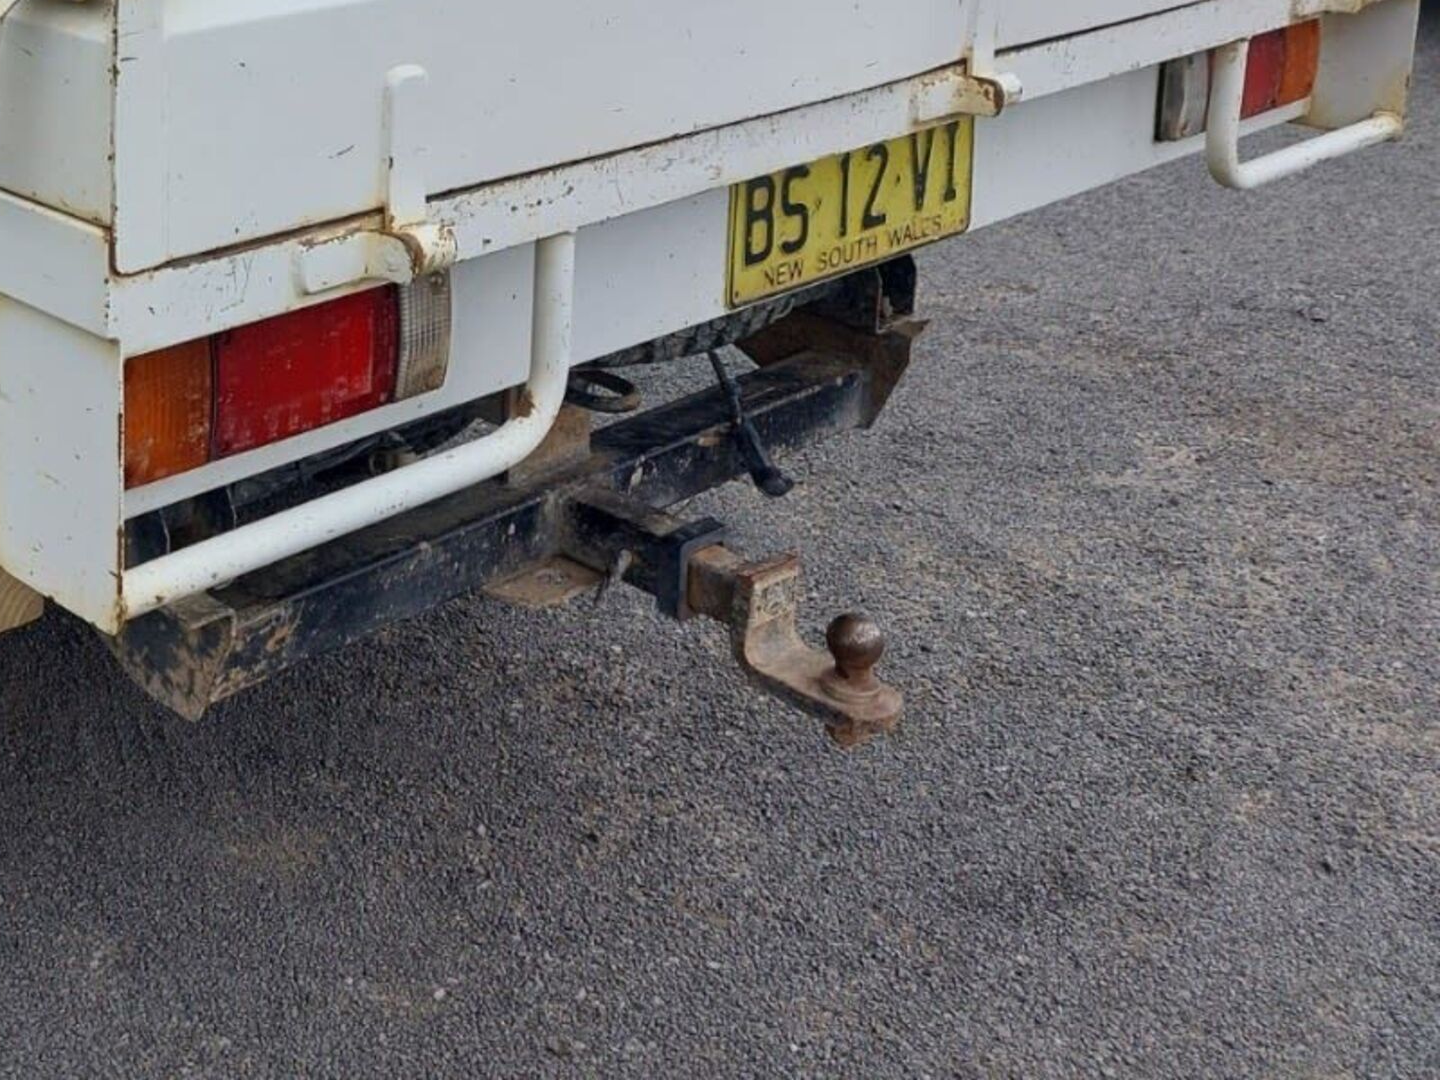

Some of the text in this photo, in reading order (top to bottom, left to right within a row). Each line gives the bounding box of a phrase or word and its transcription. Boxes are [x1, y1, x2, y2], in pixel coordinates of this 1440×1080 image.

[764, 214, 943, 289] NEW SOUTH WALES
